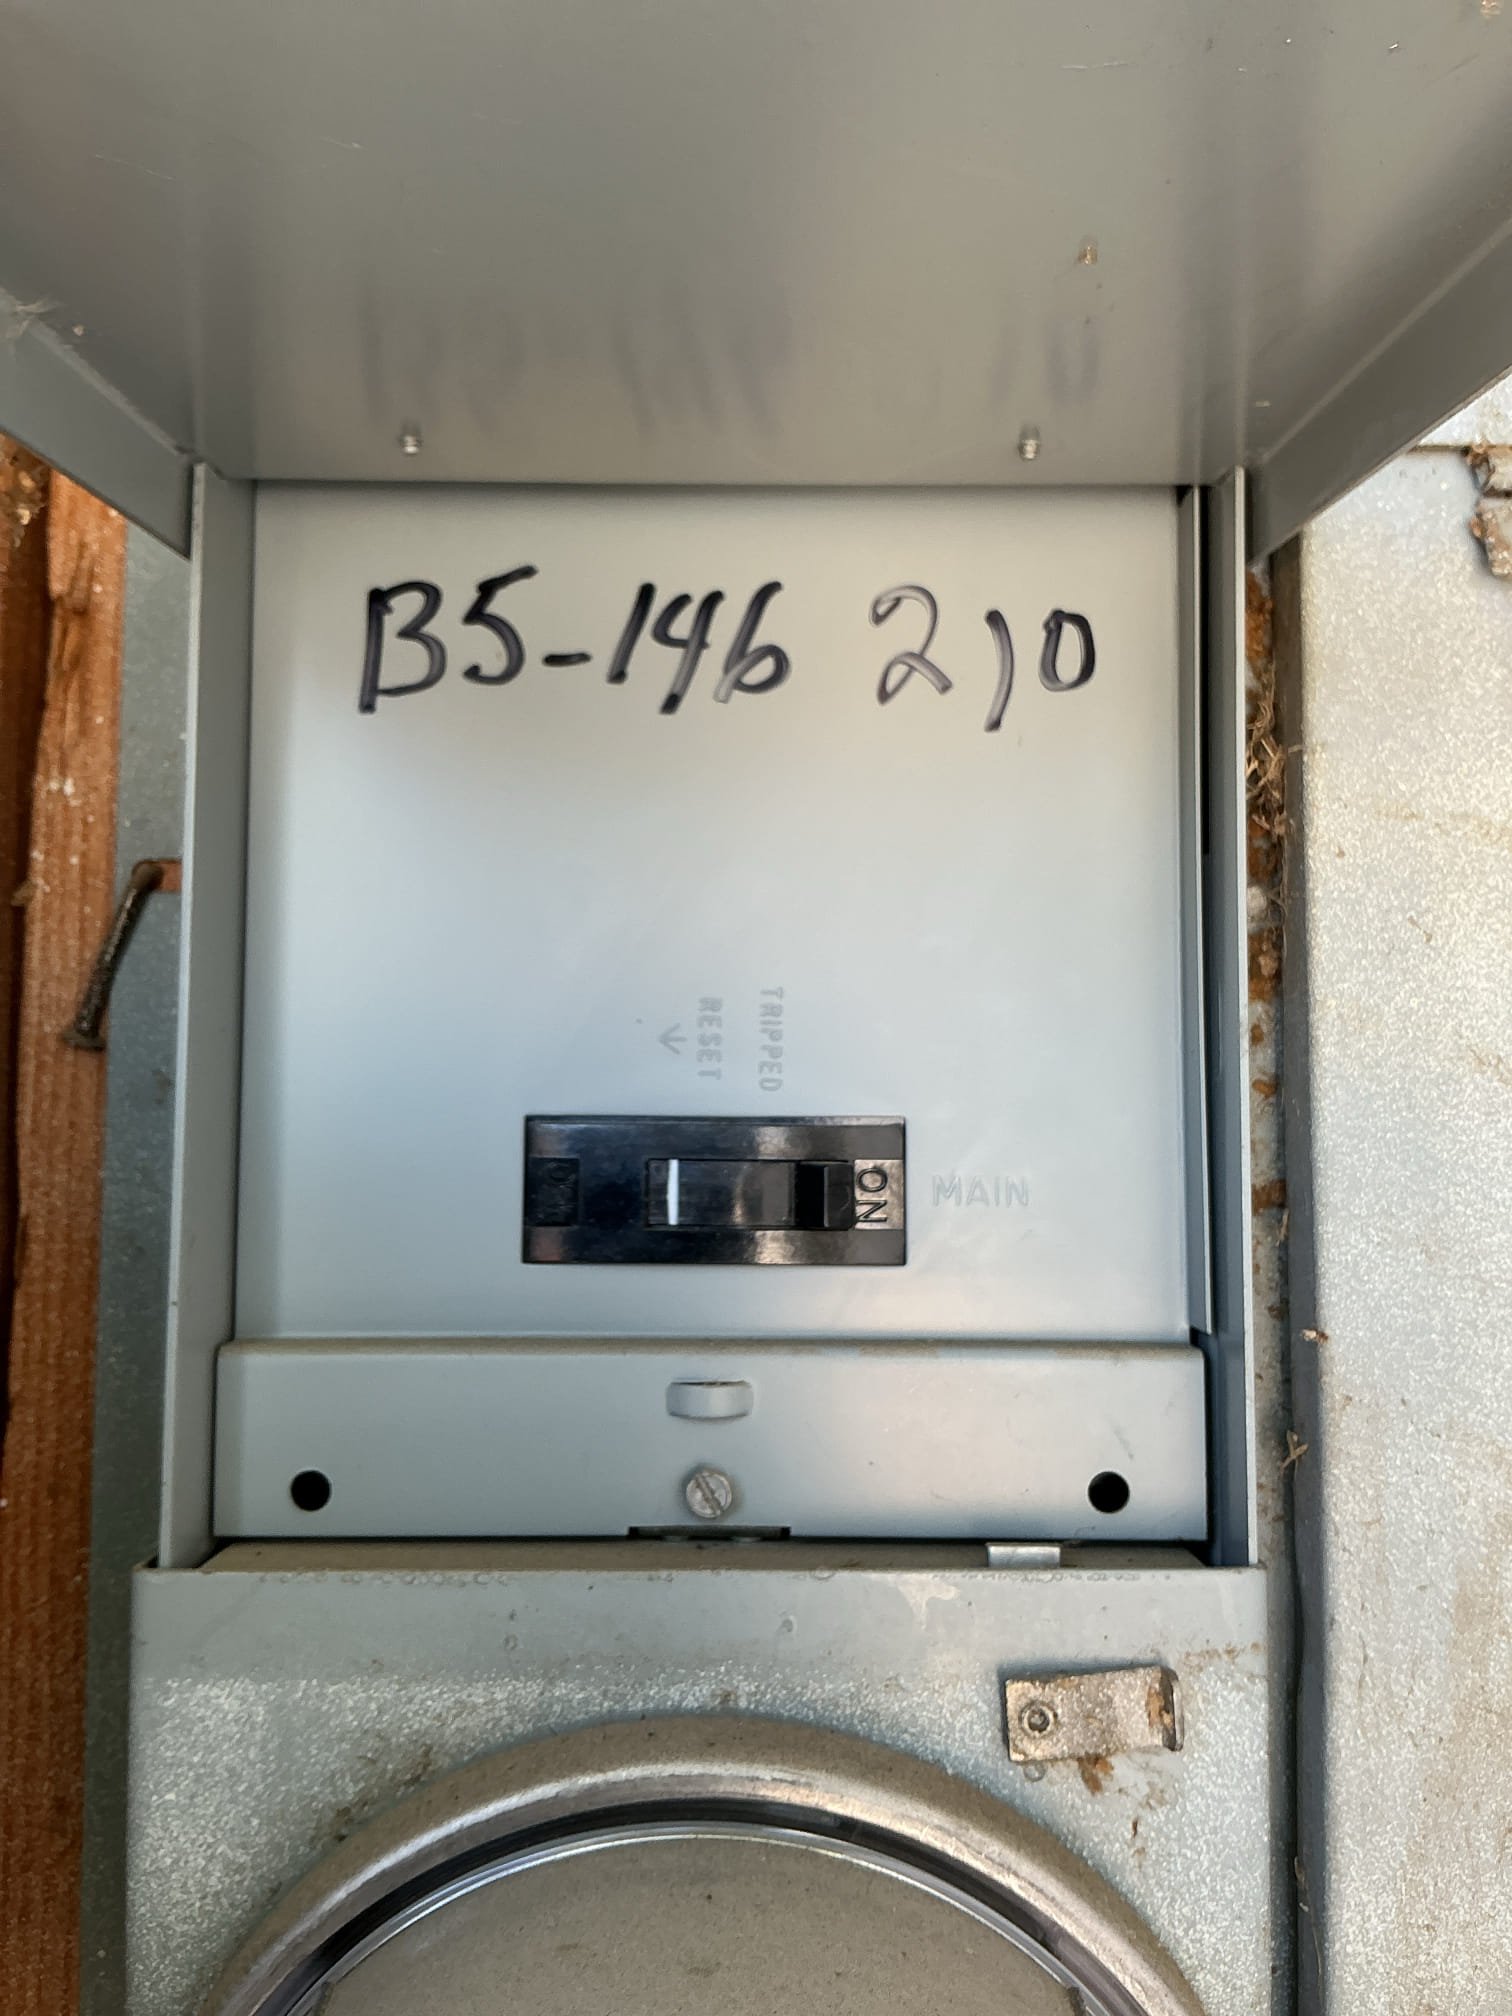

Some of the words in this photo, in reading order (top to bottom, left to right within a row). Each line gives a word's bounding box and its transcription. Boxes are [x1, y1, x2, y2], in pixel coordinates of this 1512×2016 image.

[358, 565, 790, 713] B5-146
[697, 996, 724, 1081] RESET
[758, 986, 784, 1092] TRIPPED
[856, 1166, 889, 1224] ON
[932, 1175, 1030, 1208] MAIN
